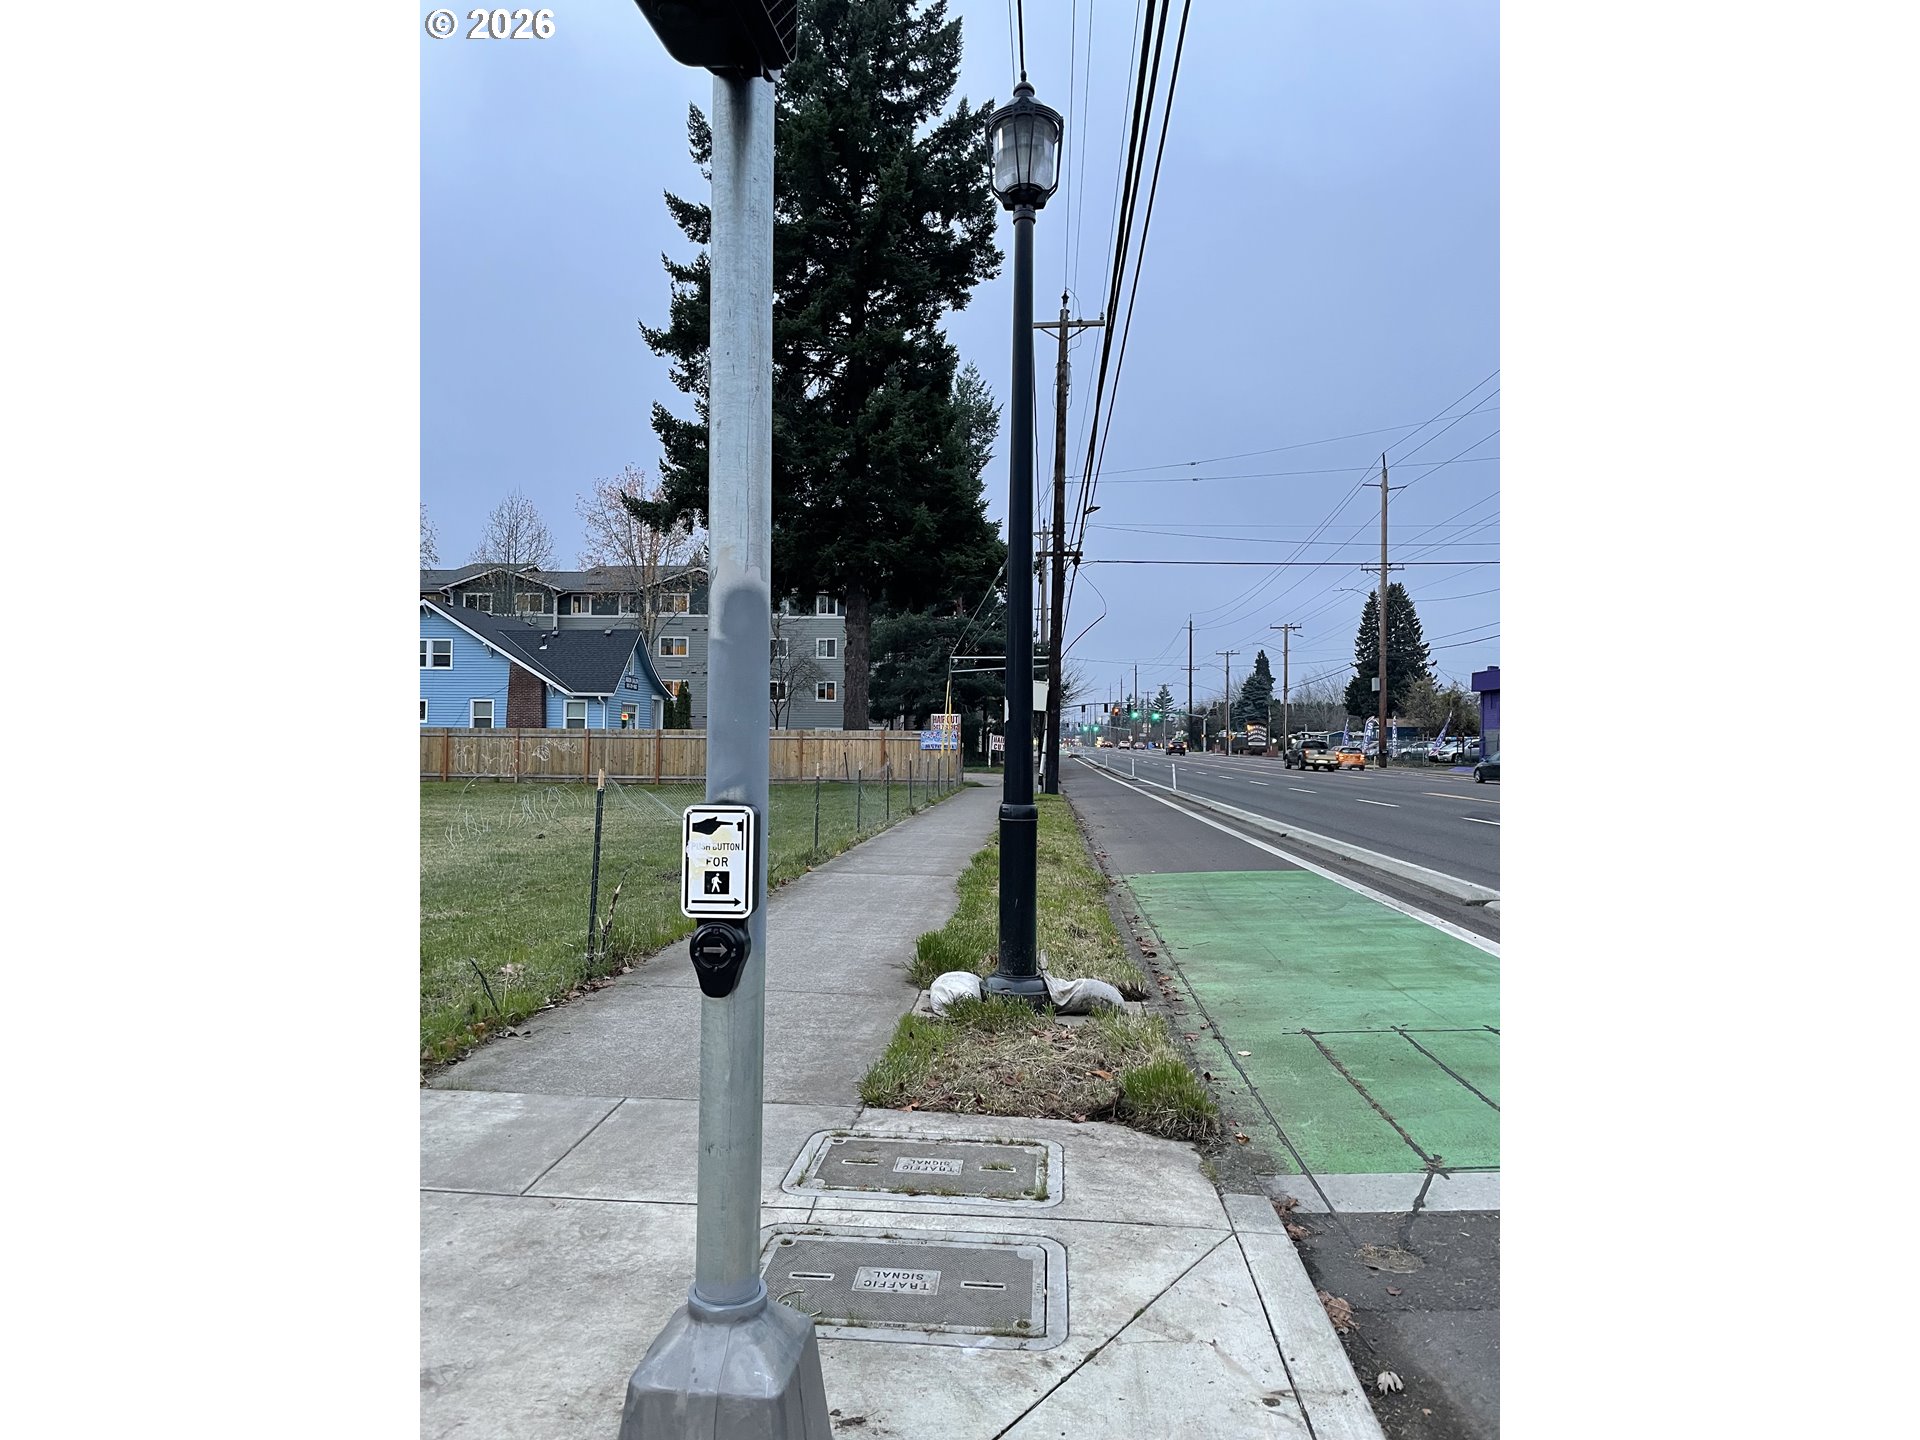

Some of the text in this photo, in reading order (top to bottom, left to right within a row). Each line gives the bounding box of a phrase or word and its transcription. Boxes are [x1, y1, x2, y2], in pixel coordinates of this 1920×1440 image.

[706, 857, 728, 866] FOR
[873, 1270, 924, 1280] SIGNAL
[863, 1279, 929, 1291] TRAFFIC
